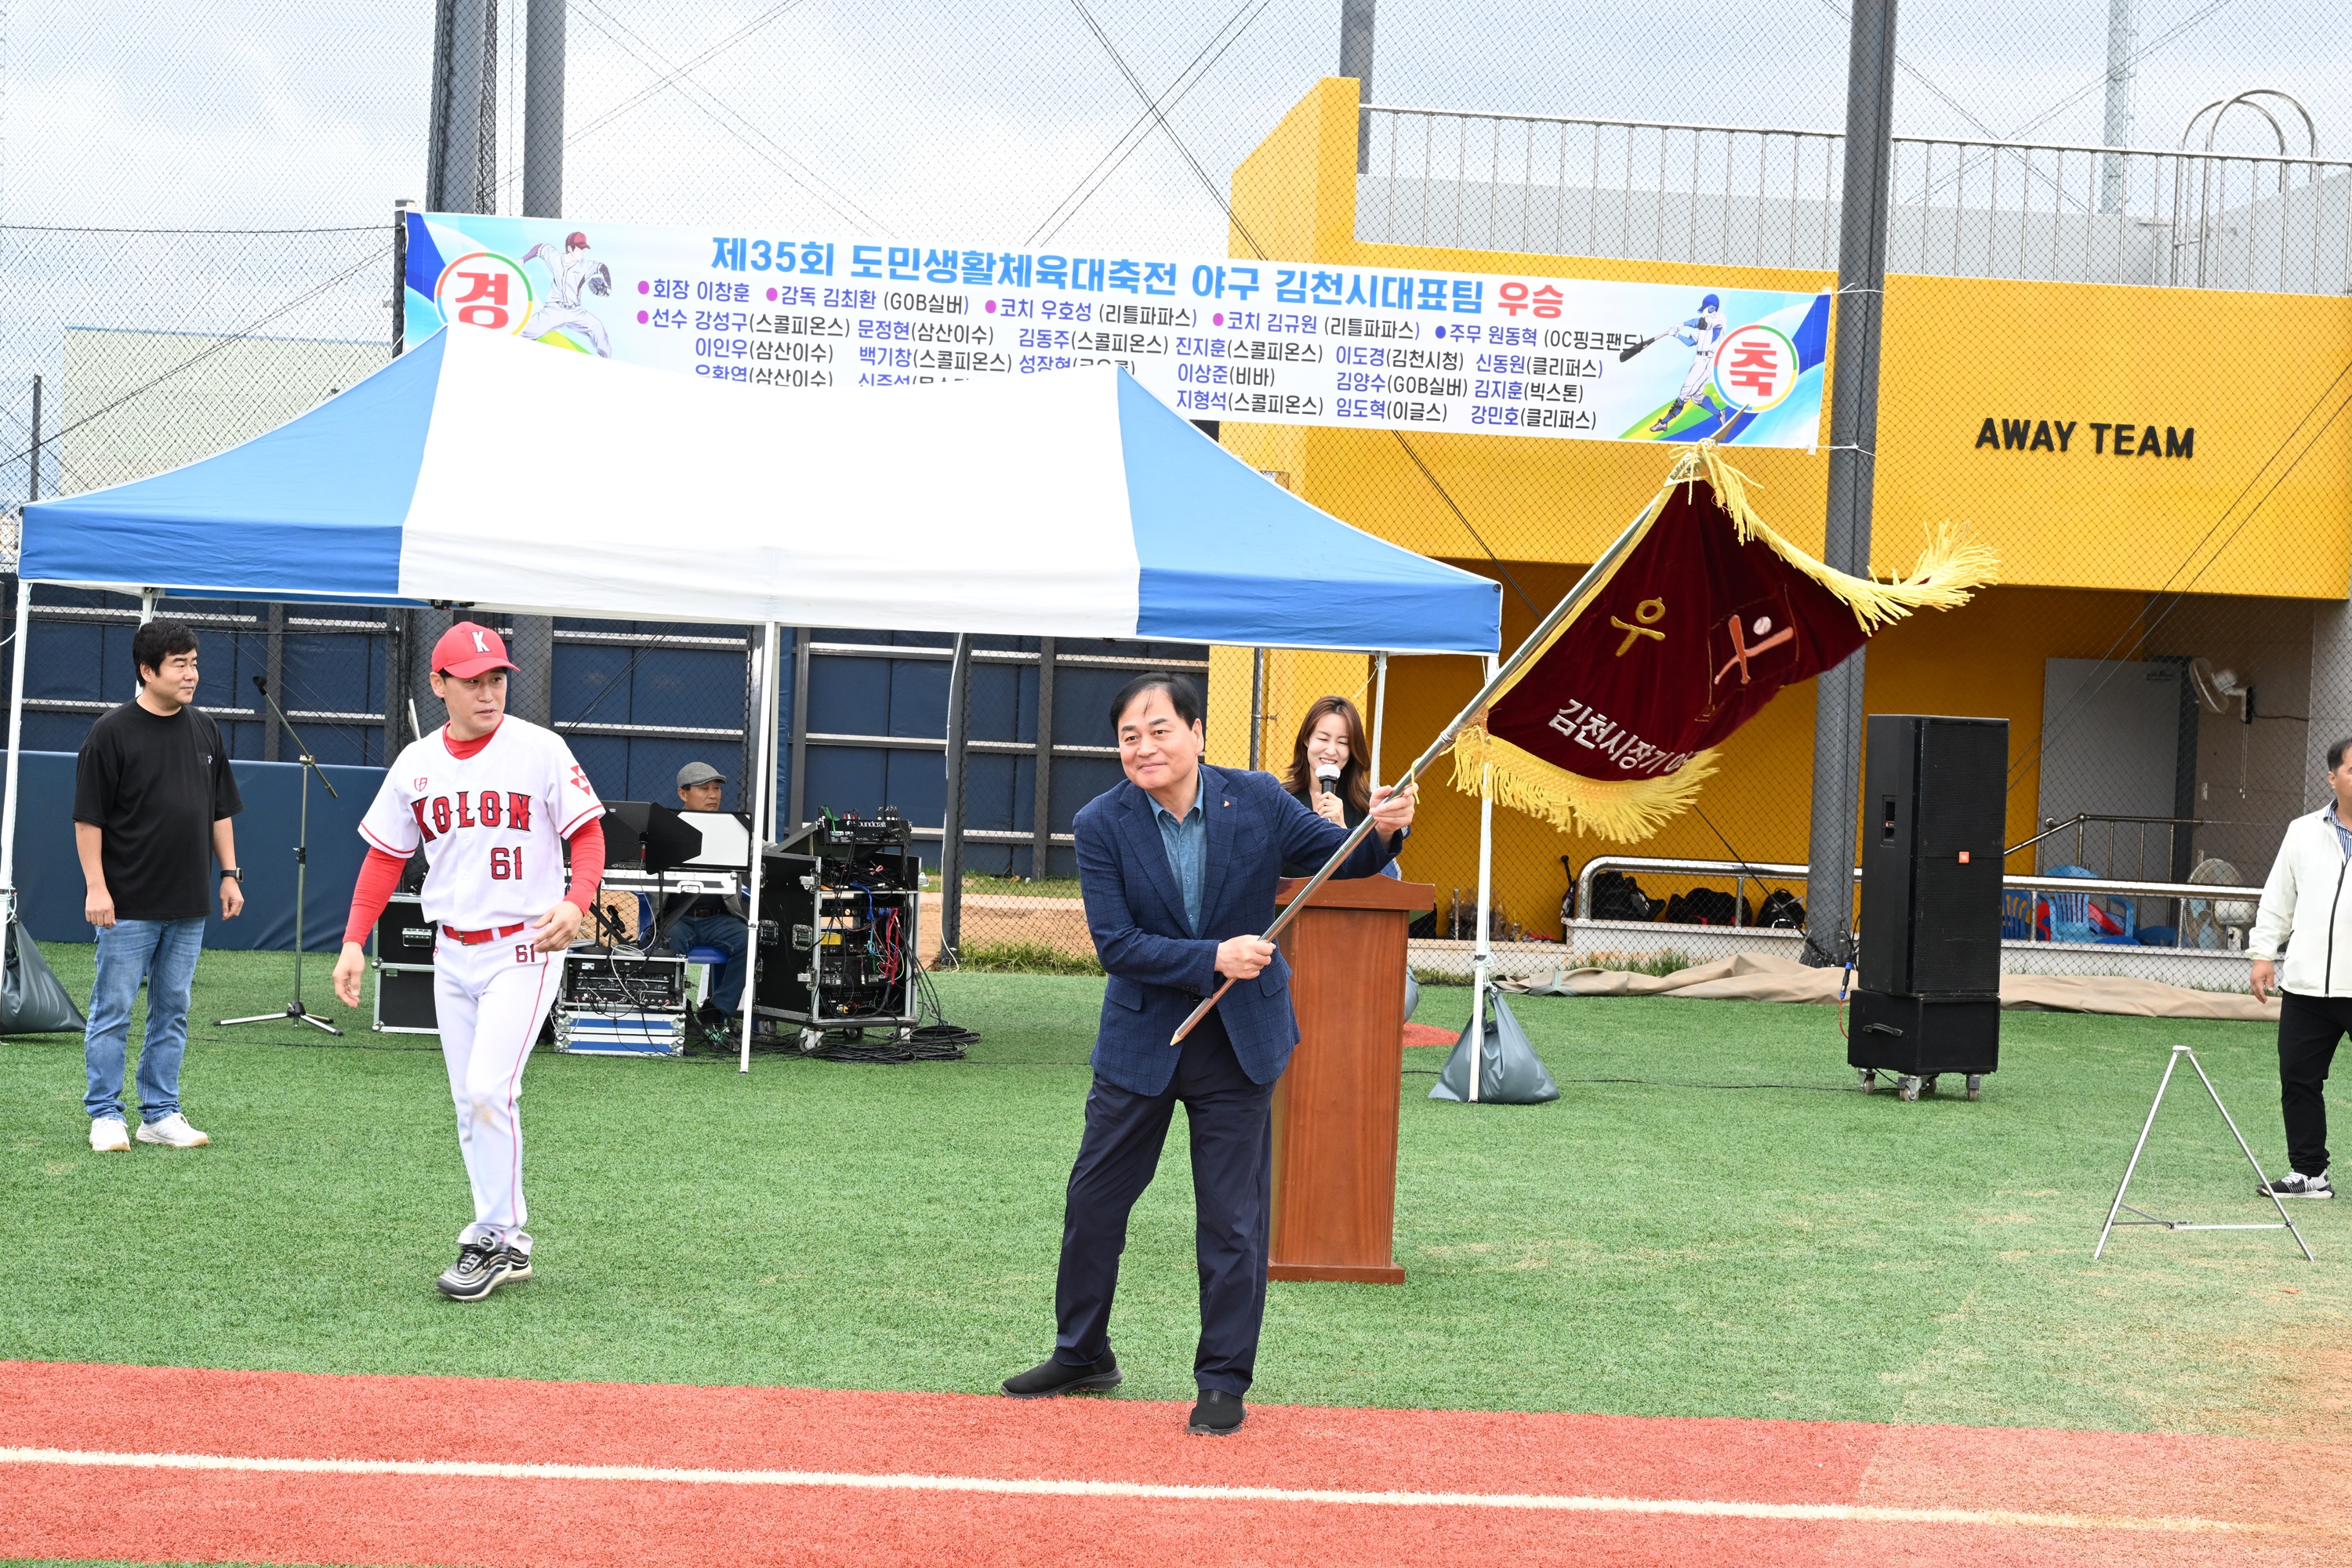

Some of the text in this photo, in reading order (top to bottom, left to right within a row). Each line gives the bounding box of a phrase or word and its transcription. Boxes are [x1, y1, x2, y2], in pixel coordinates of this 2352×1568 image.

[456, 272, 508, 328] 경
[711, 238, 1563, 318] 제35회 도민생활체육대축전 야구 김천시대표팀 우승
[654, 278, 689, 299] 회장
[698, 281, 749, 302] 이창훈
[782, 286, 815, 307] 감독
[824, 289, 876, 309] 김최환
[884, 292, 968, 314] (GOB실버)
[1000, 299, 1033, 318] 코치
[1041, 300, 1091, 321] 우호성
[1100, 304, 1196, 328] (리틀파파스)
[1228, 312, 1259, 331] 코치
[1268, 314, 1316, 333] 김규원
[1325, 317, 1419, 340] (리틀파파스)
[1450, 325, 1481, 343] 주무
[1489, 326, 1537, 347] 원동혁
[652, 309, 1602, 379] 선수 강성구(스콜피온스) 문정현(삼산이수) 김동주(스콜피온스) 진지훈(스콜피온스) 이도경(김천시청) 신동원(클리퍼스)
[696, 338, 833, 363] 이인우(삼산이수)
[860, 347, 1011, 372] 백기창(스콜피온스)
[1178, 364, 1274, 387] 이상준(비바)
[1338, 372, 1467, 397] 김양수(GOB실버)
[1475, 380, 1583, 403] 김지훈(빅스톤)
[1730, 342, 1777, 396] 축
[1177, 390, 1323, 416] 지형석(스콜피온스)
[1337, 398, 1446, 423] 임도혁(이글스)
[1472, 406, 1595, 430] 강민호(클리퍼스)
[1975, 418, 2194, 458] AWAY TEAM
[471, 631, 491, 653] K
[1611, 597, 1665, 657] 우
[1548, 699, 1675, 774] 김천시장기
[410, 790, 533, 844] KOLON
[490, 846, 523, 880] 61
[515, 943, 535, 963] 61
